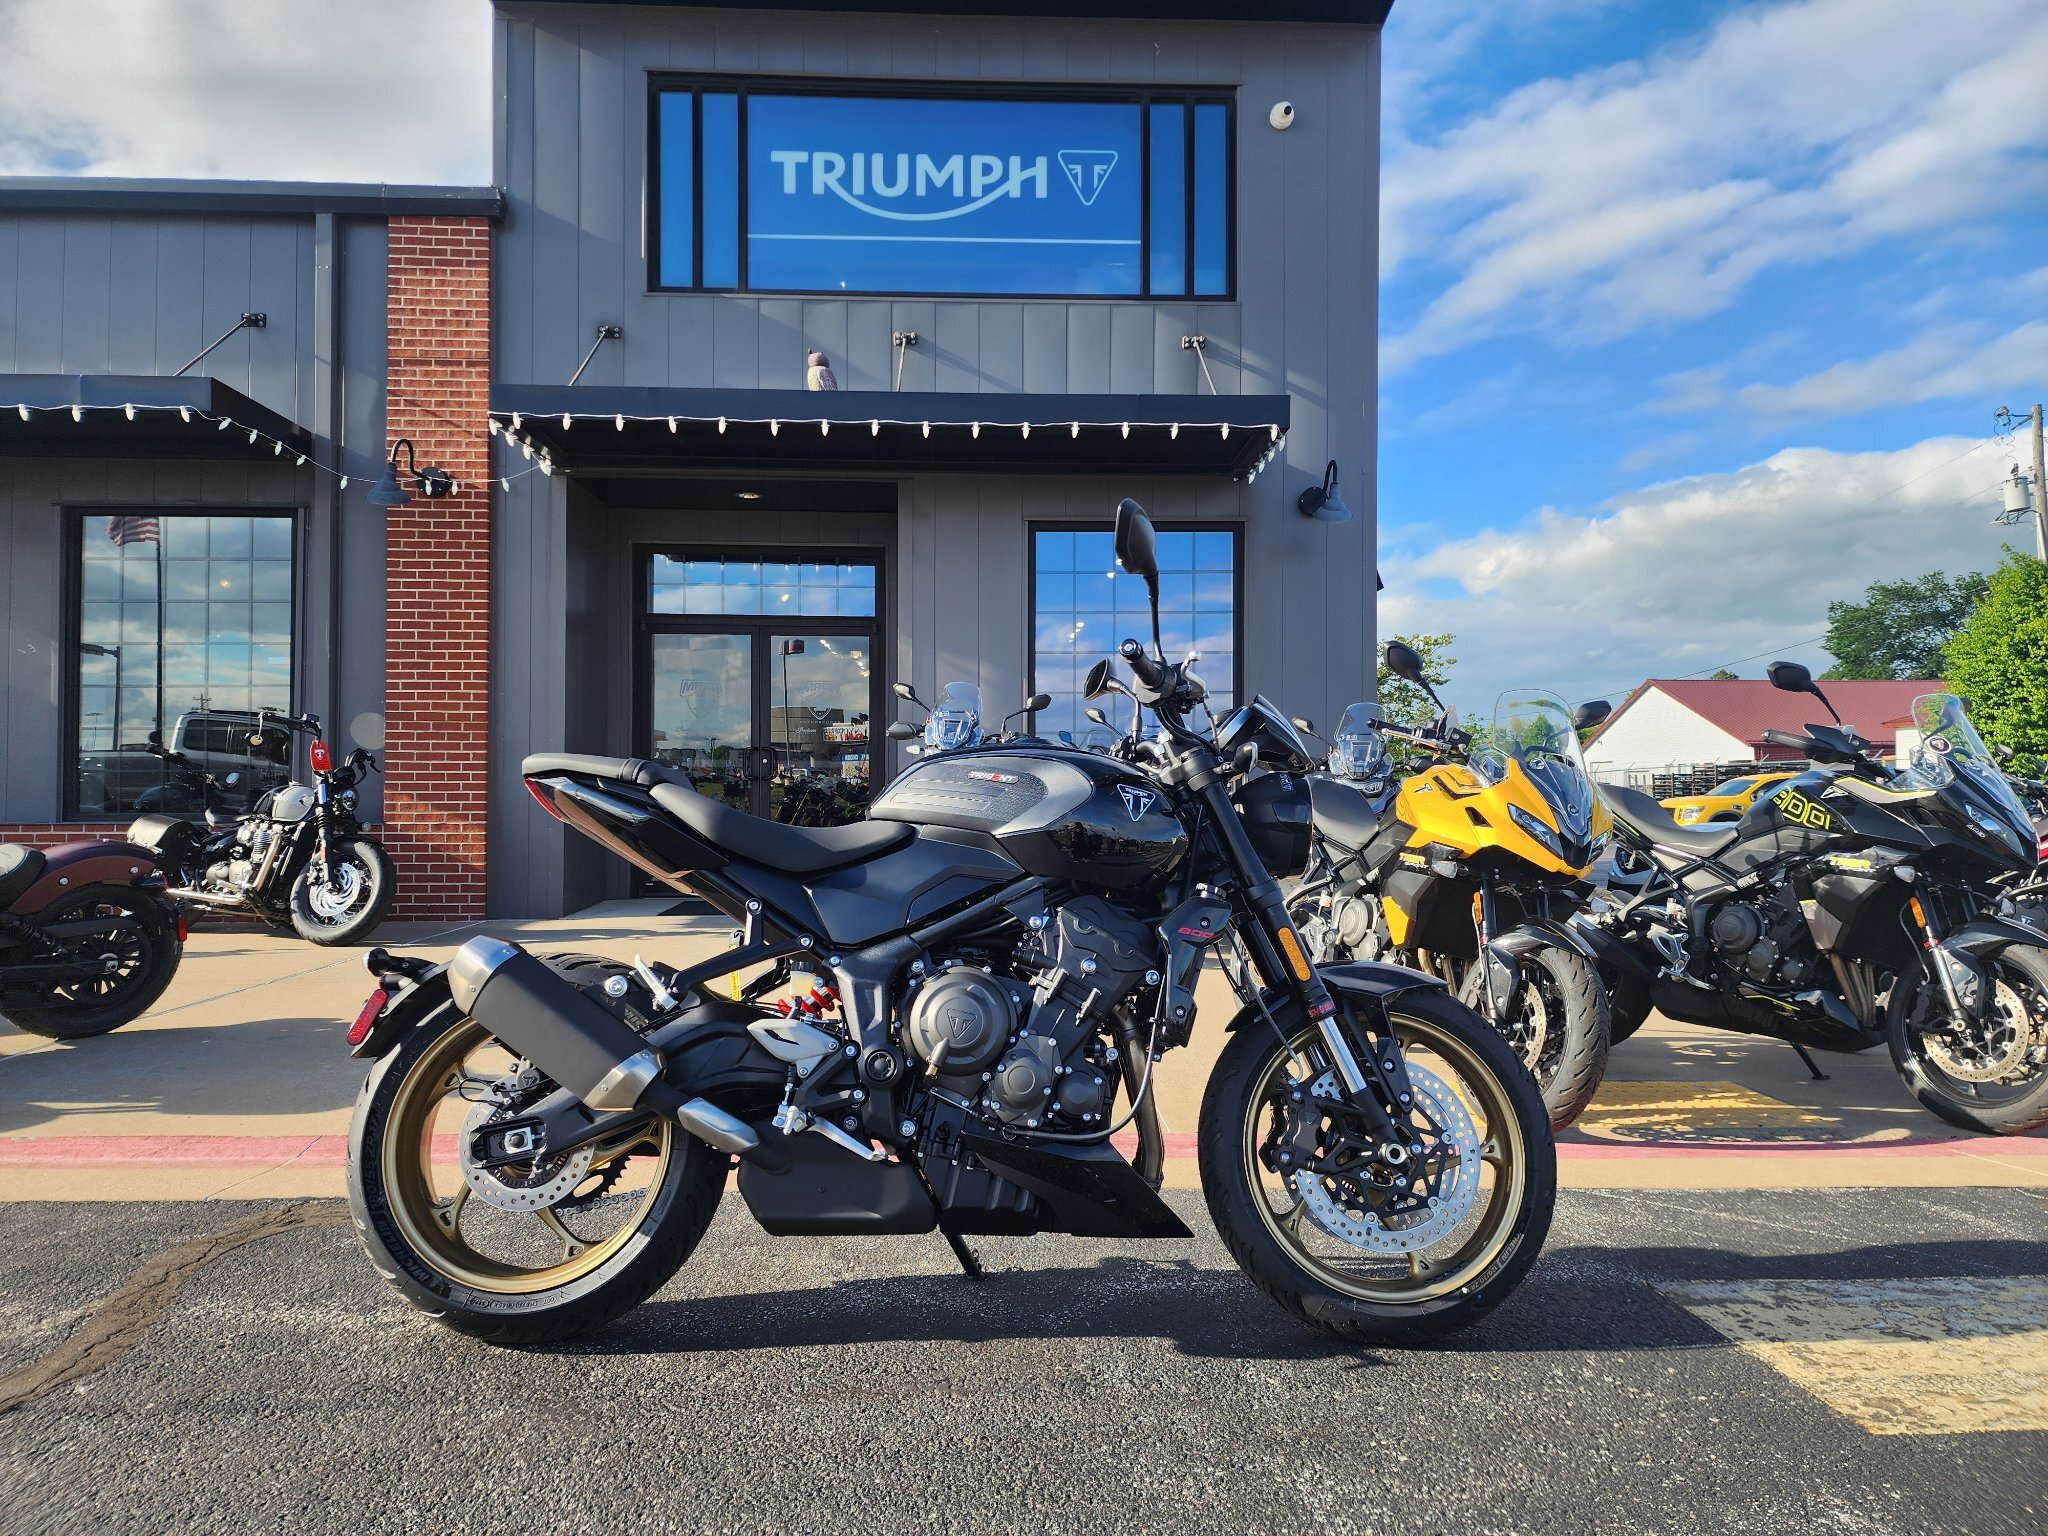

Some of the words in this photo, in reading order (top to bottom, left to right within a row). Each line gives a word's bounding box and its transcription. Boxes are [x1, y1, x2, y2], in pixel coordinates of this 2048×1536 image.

[770, 149, 1048, 222] TRIUMPH
[967, 771, 1019, 783] TRIDENT
[1178, 927, 1215, 941] 800
